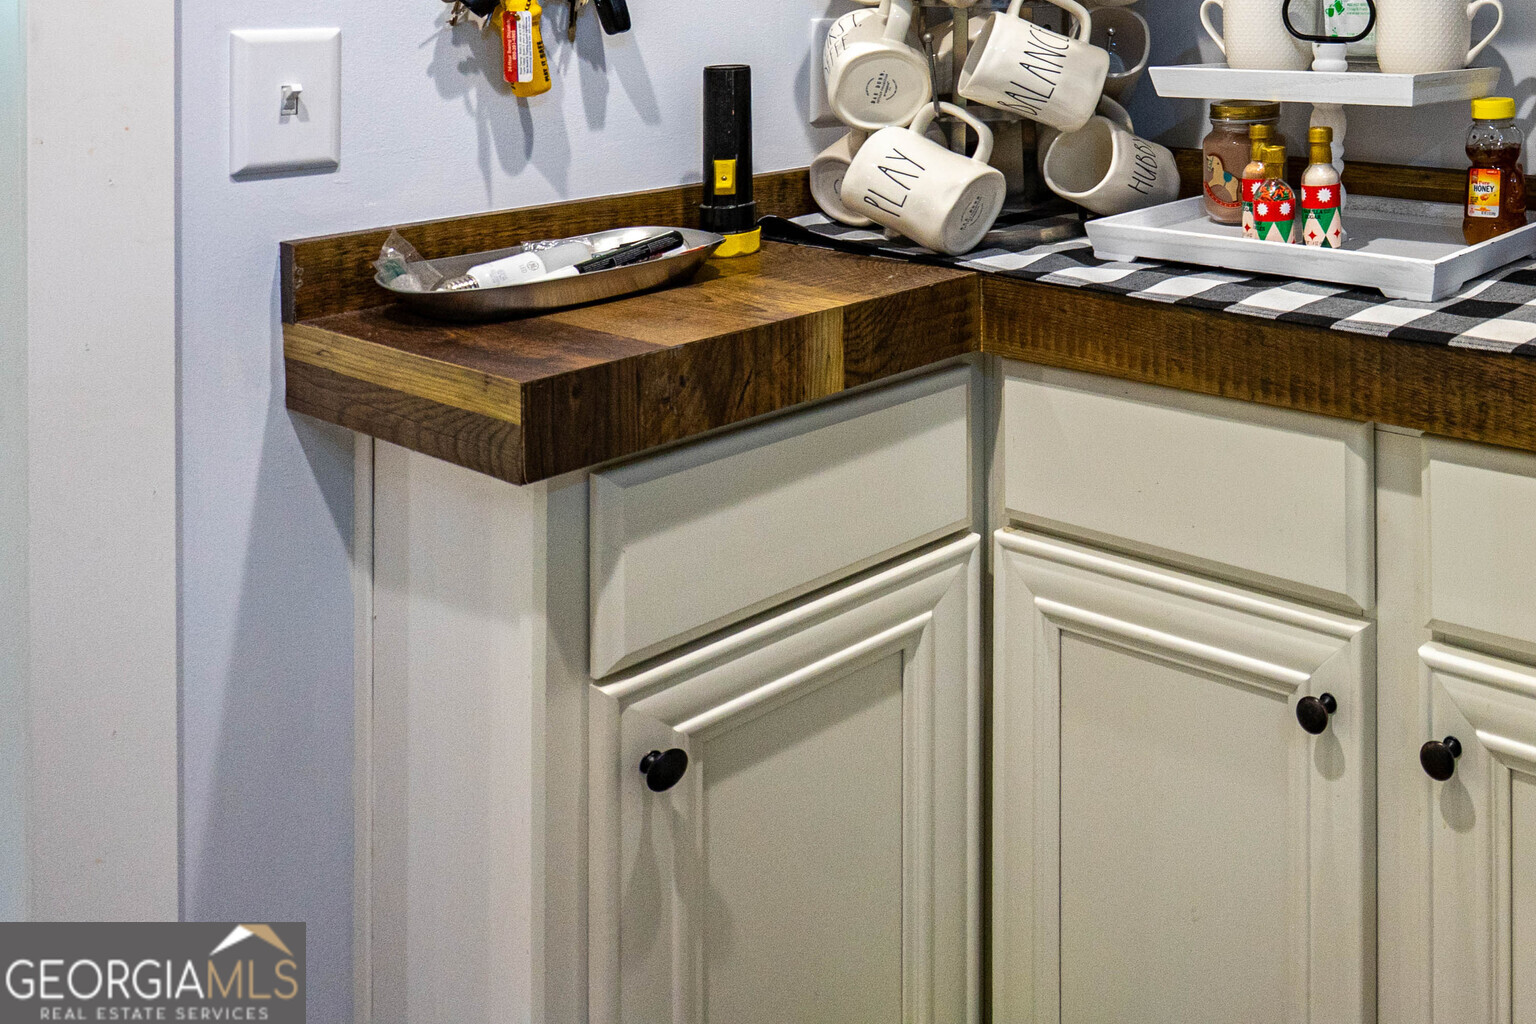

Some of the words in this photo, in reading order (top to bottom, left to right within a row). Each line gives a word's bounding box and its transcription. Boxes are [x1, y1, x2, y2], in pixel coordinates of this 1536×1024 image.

[996, 23, 1071, 116] BALANCE
[863, 147, 926, 218] PLAY
[1127, 138, 1158, 195] HUBBY
[1473, 184, 1495, 193] HONEY
